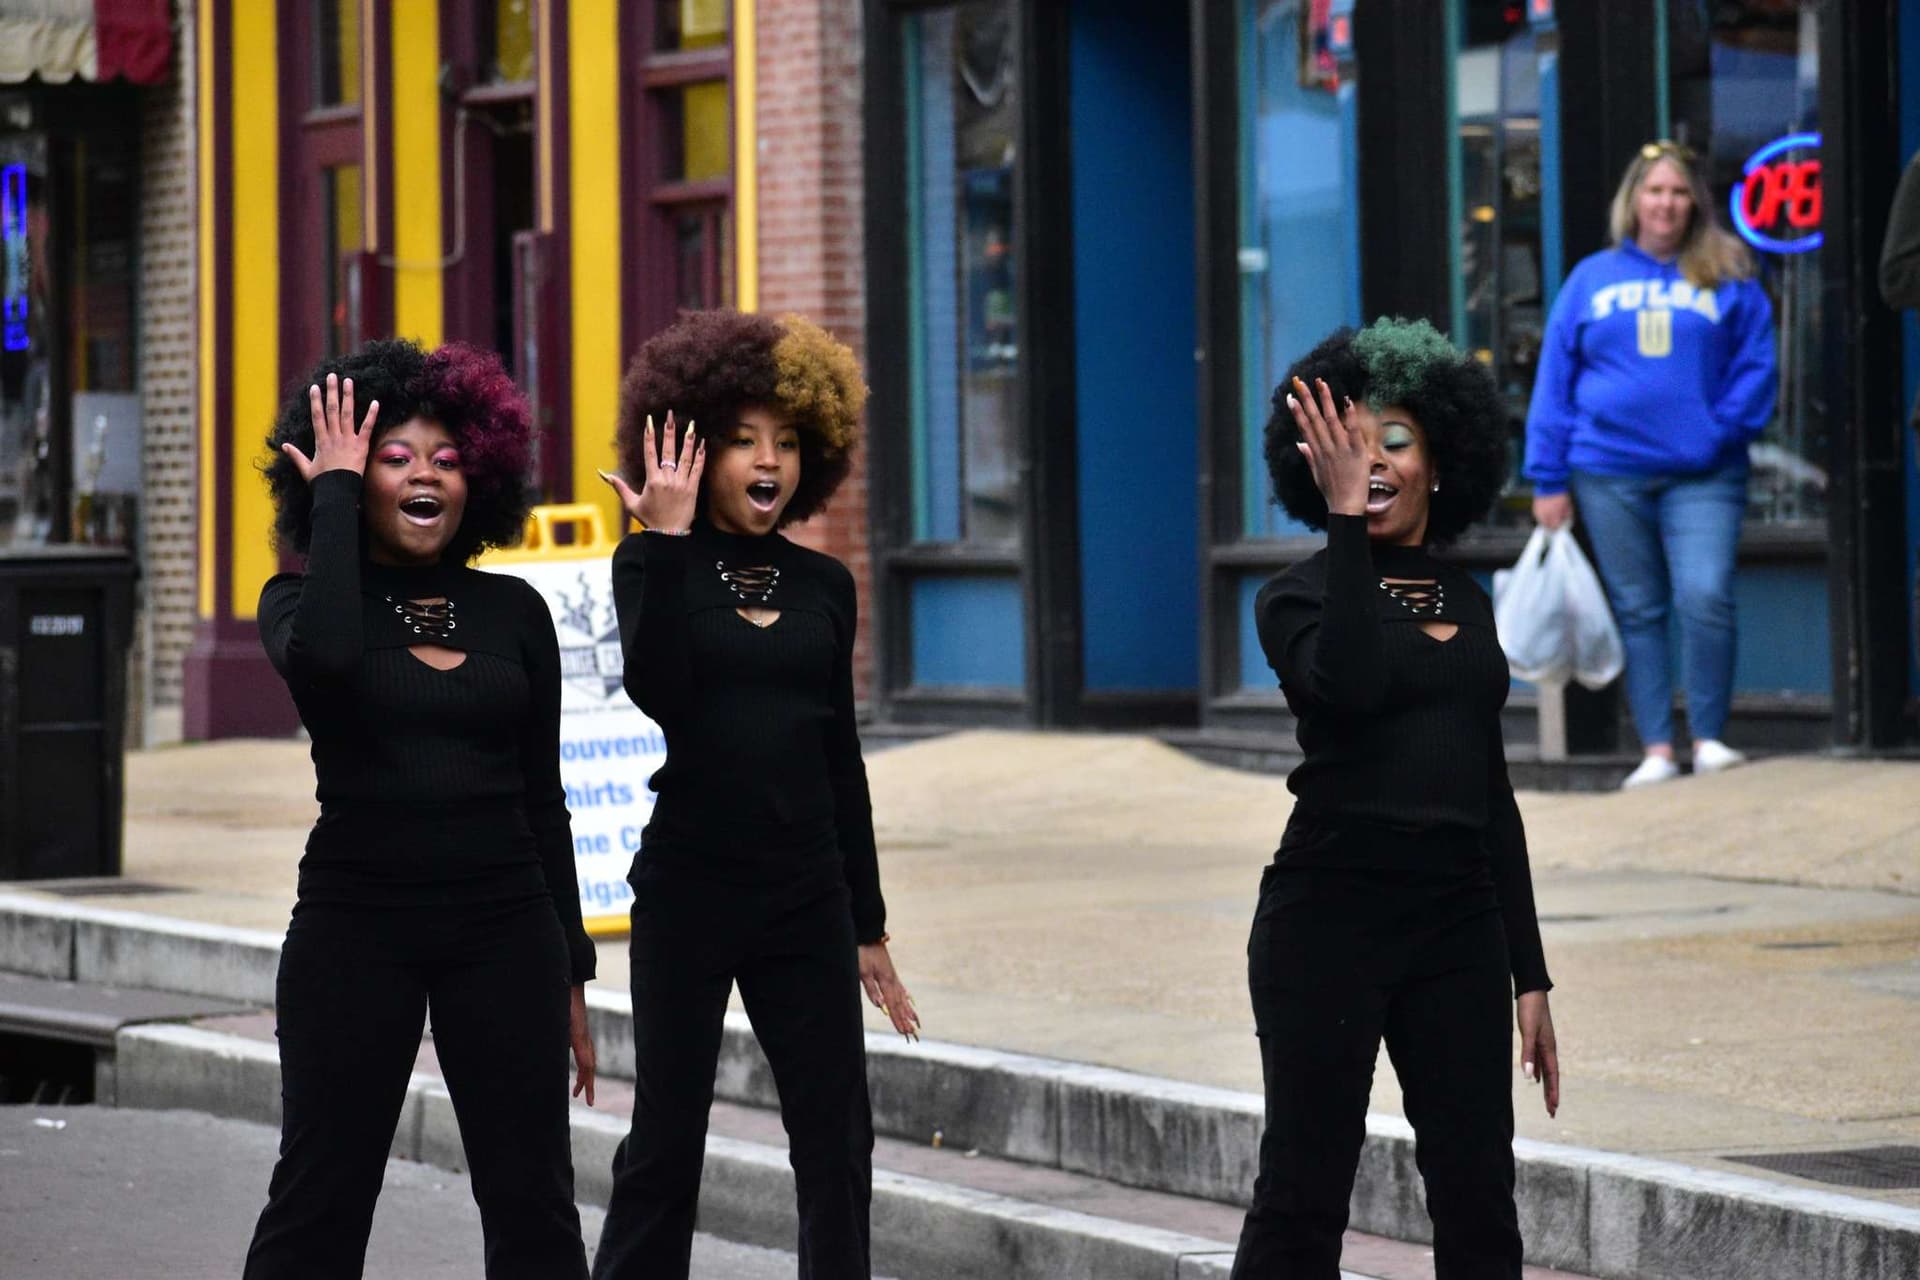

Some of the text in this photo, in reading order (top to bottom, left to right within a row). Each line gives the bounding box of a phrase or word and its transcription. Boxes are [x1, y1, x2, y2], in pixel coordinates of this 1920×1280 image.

[1592, 280, 1719, 323] TULSA
[561, 729, 666, 761] ouveni
[566, 780, 633, 808] hirts
